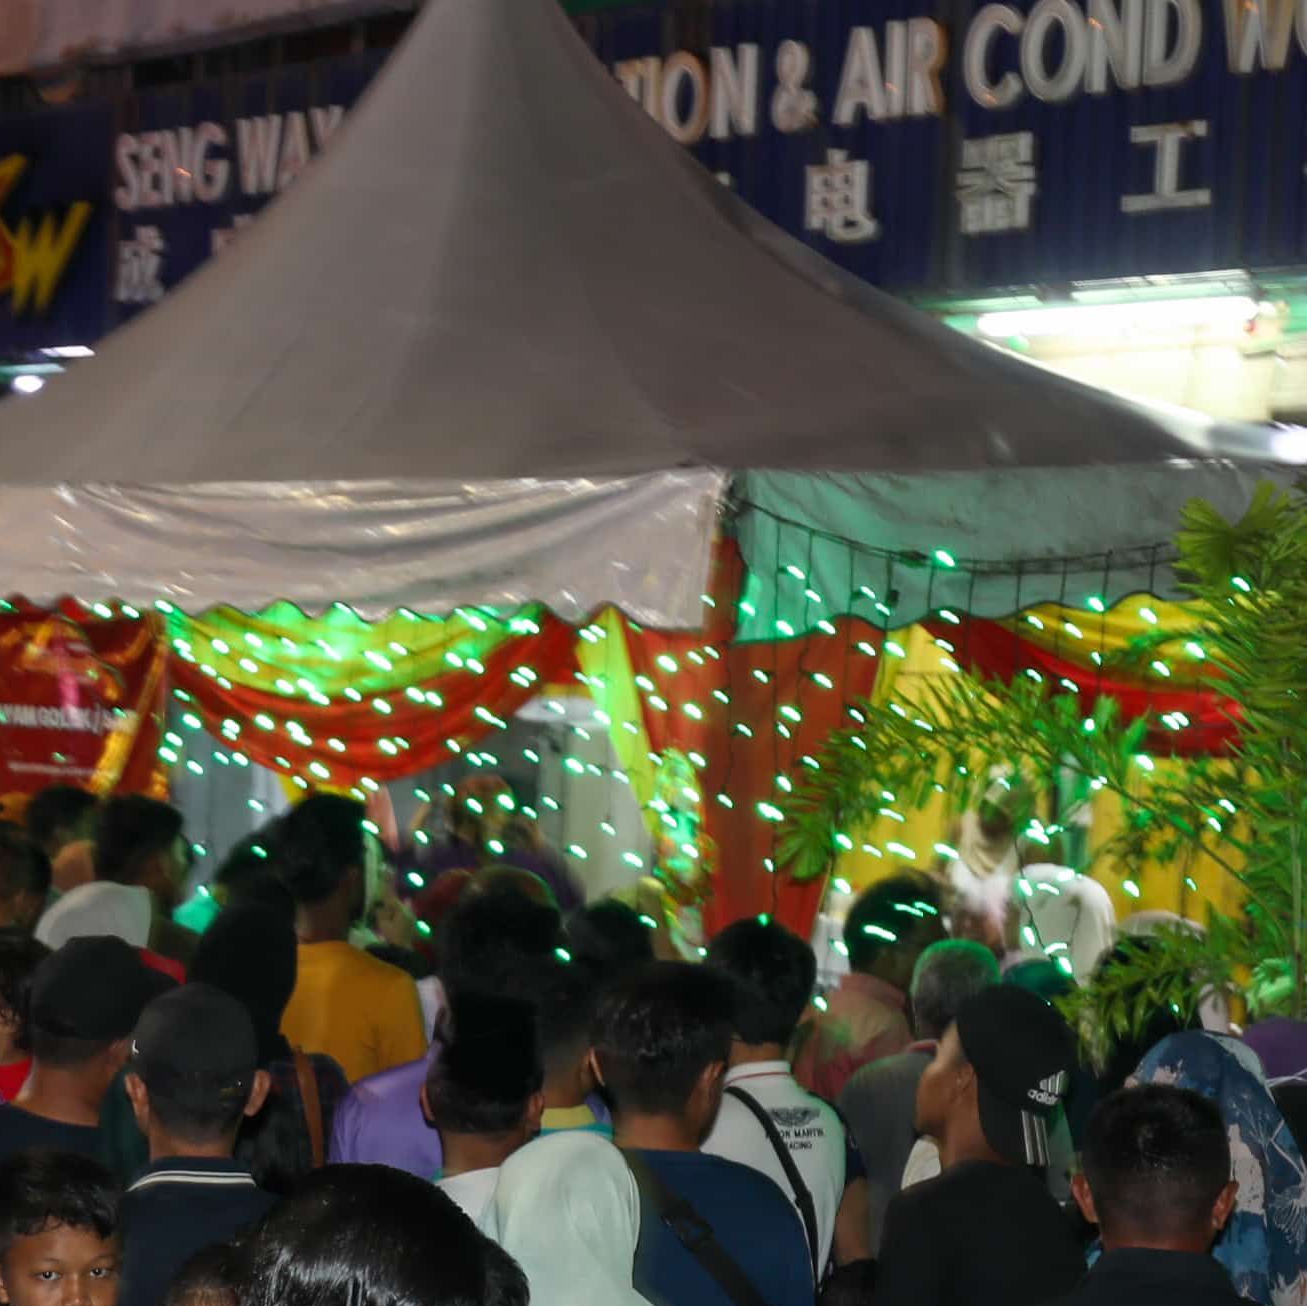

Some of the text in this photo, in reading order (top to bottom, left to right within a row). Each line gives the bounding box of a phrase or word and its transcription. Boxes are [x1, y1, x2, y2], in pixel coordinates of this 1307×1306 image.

[770, 39, 818, 133] &
[832, 16, 949, 127] AIR
[964, 0, 1202, 108] COND
[1222, 0, 1307, 73] W
[113, 121, 230, 212] SENG
